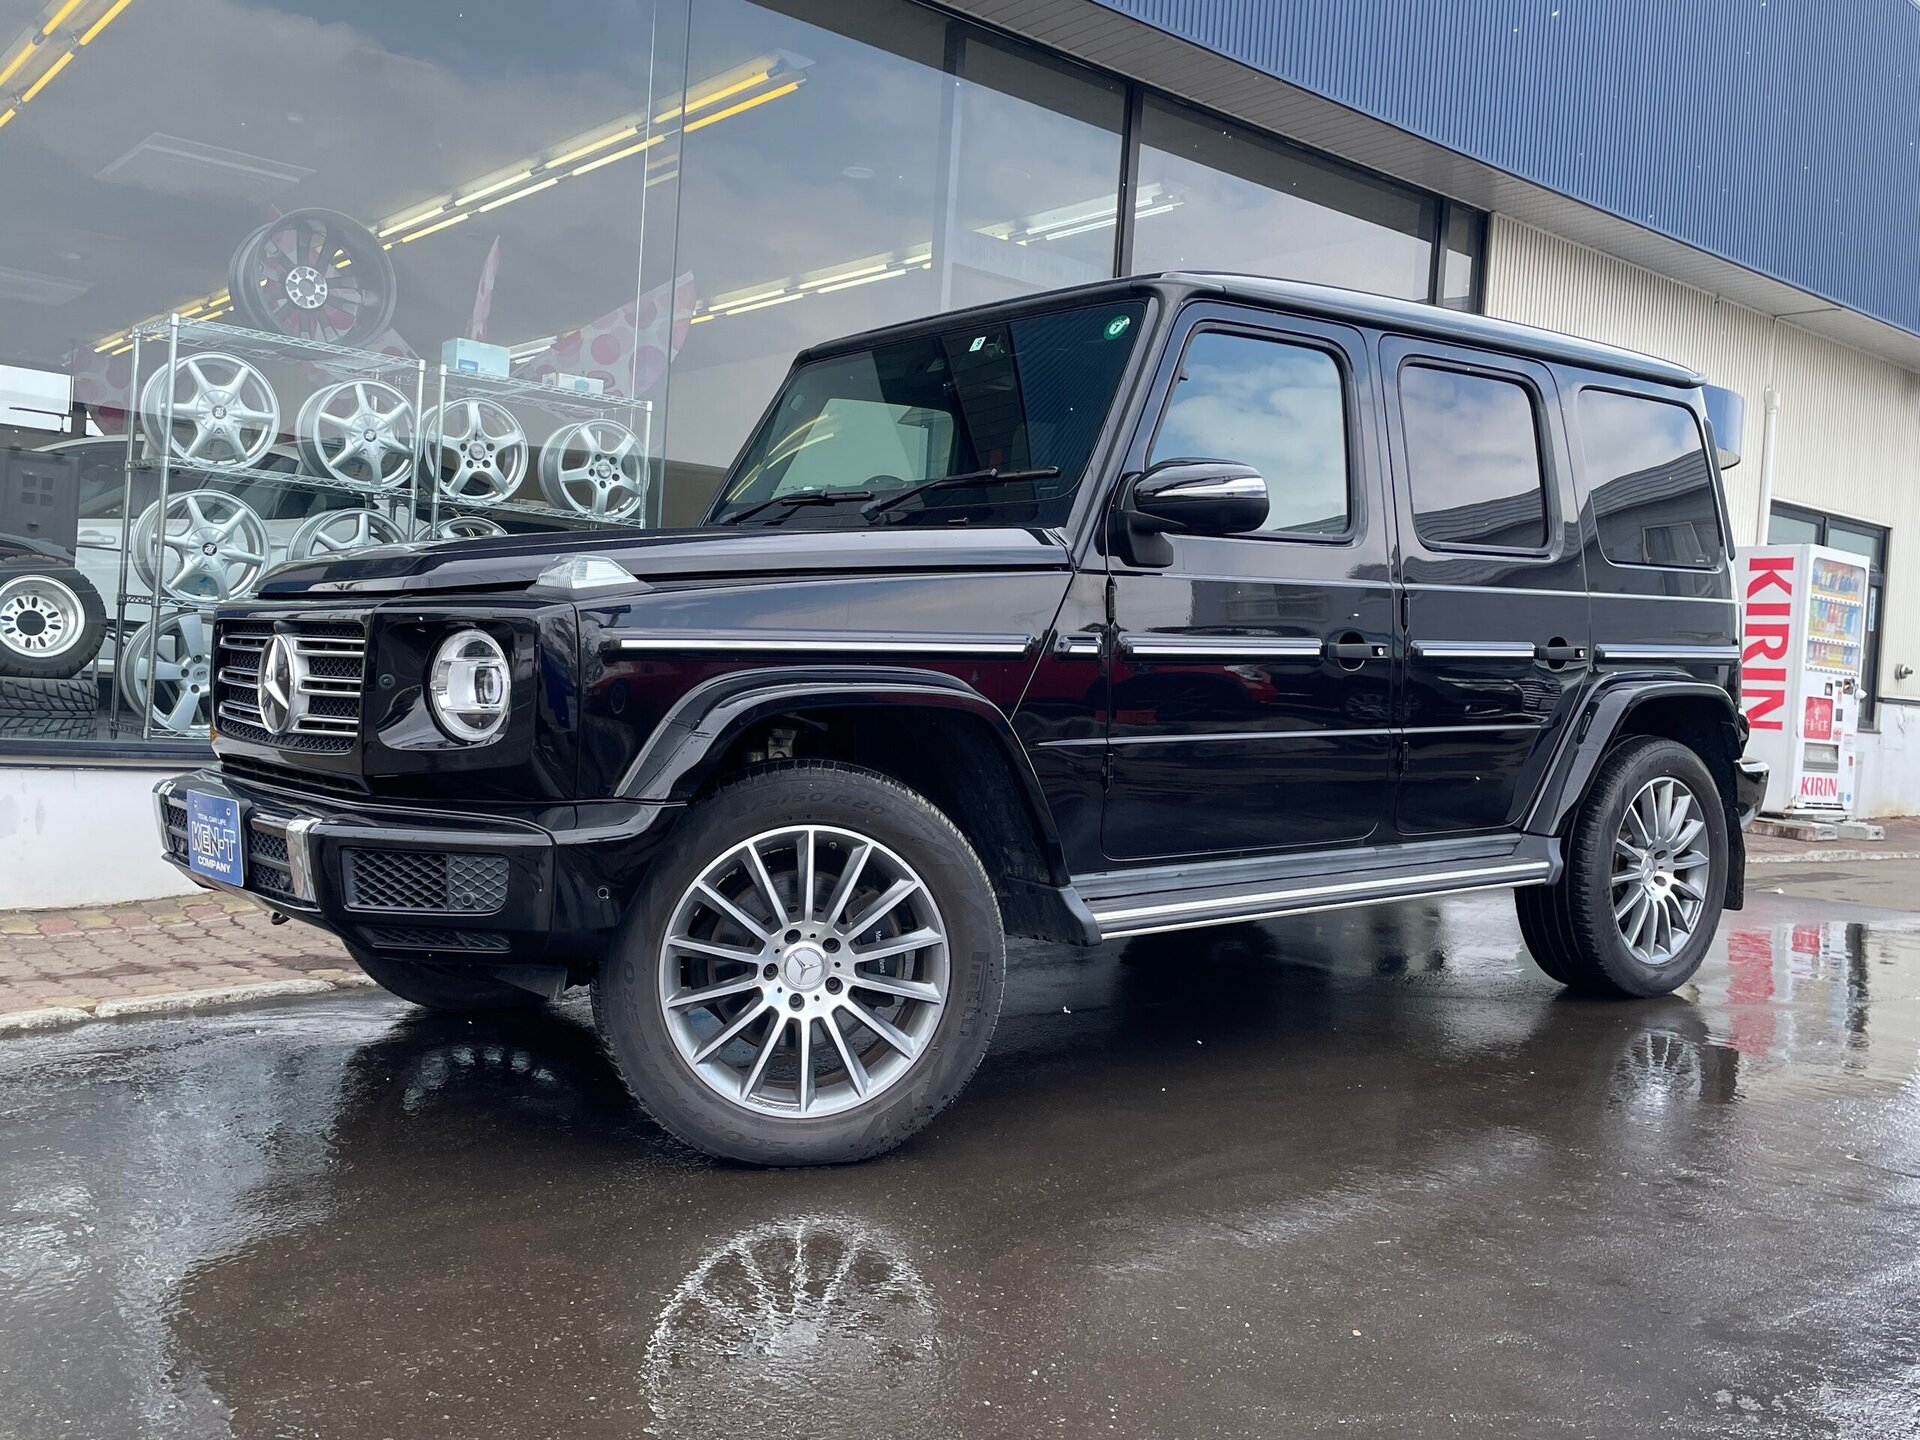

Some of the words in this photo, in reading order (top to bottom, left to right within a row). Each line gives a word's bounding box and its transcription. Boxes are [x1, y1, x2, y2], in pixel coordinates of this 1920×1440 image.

[1742, 557, 1795, 731] KIRIN
[1801, 777, 1838, 797] KIRIN
[198, 856, 231, 874] COMPANY
